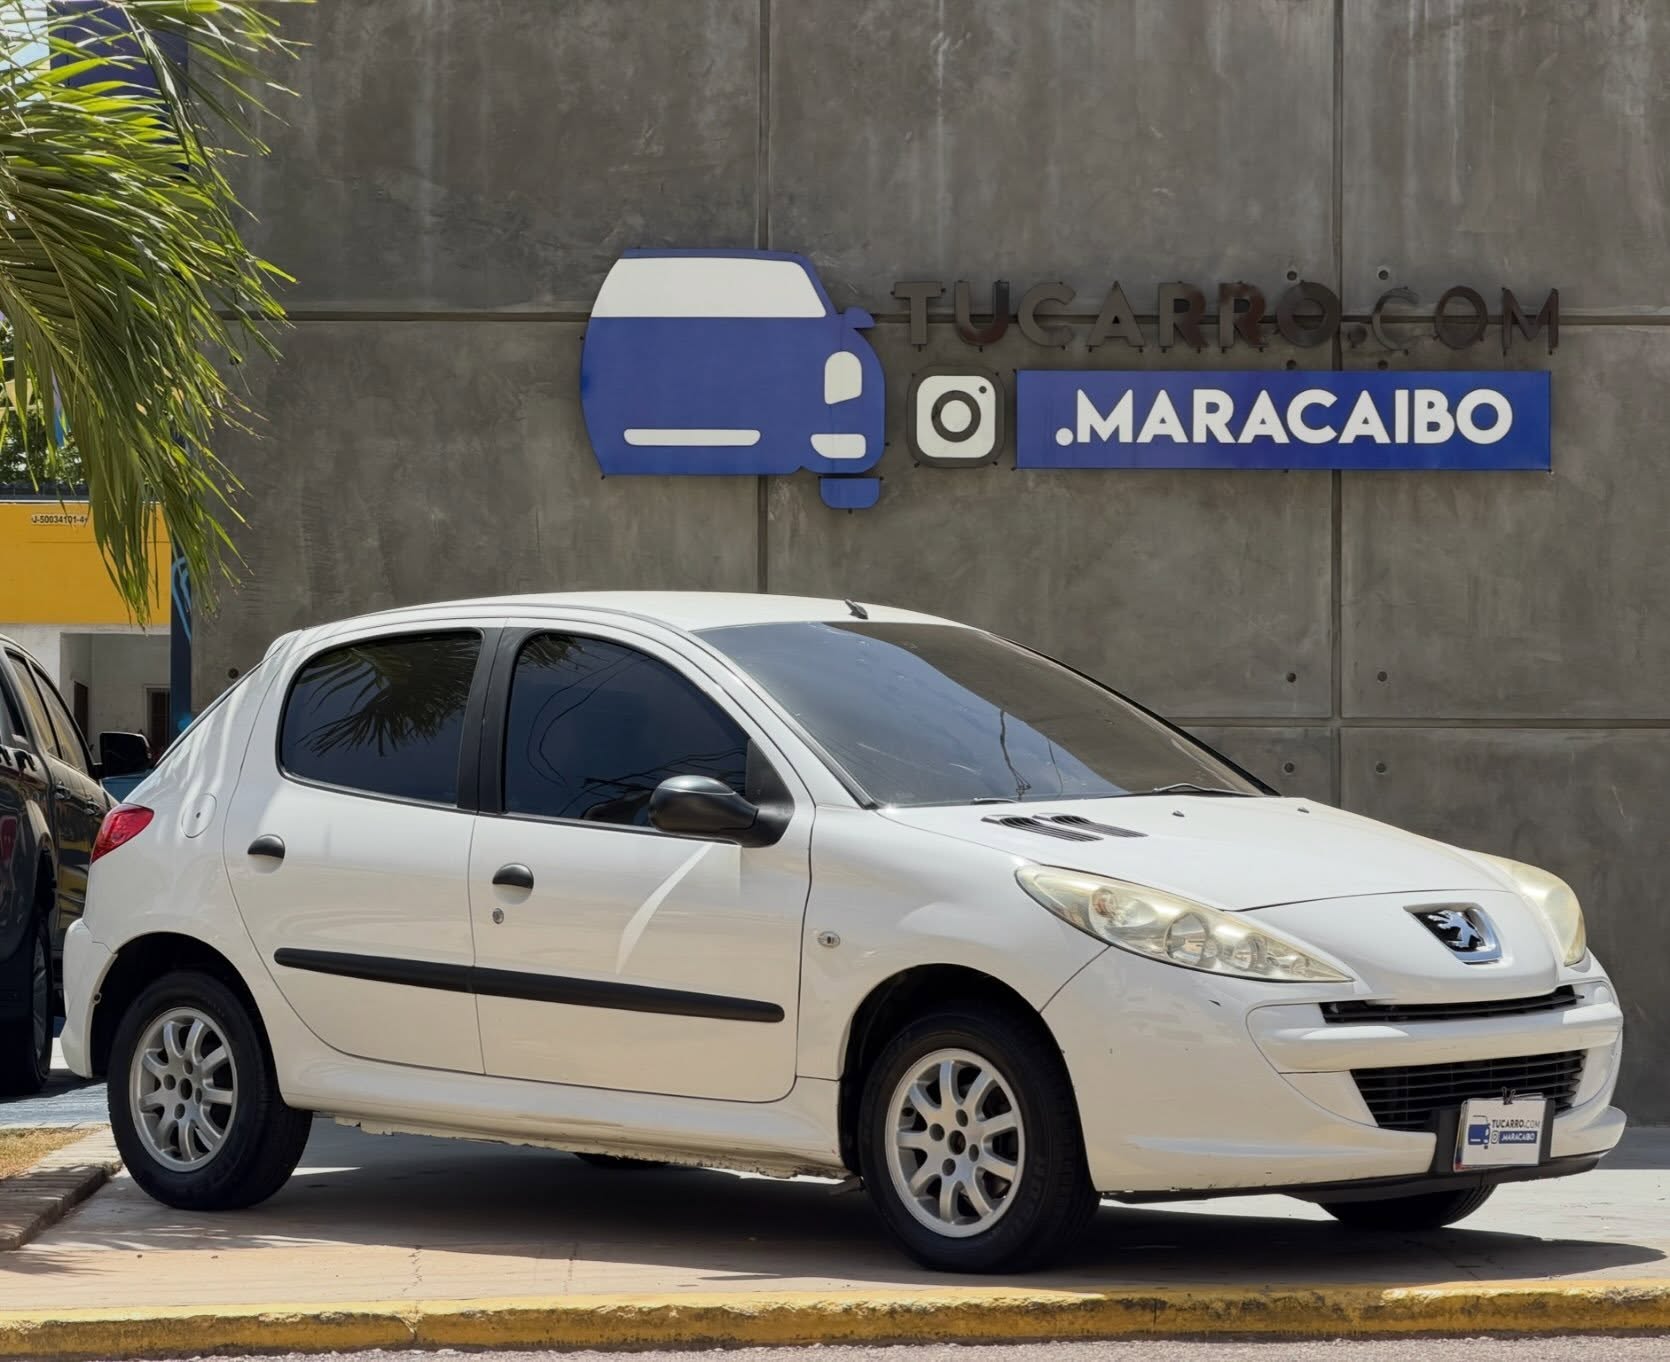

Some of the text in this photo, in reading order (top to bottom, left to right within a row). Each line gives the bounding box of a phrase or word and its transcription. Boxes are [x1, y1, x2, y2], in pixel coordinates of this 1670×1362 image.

[893, 281, 1559, 350] TUCARRO.COM
[1055, 388, 1513, 446] .MARACAIBO
[1491, 1119, 1540, 1128] TUCARRO.COM
